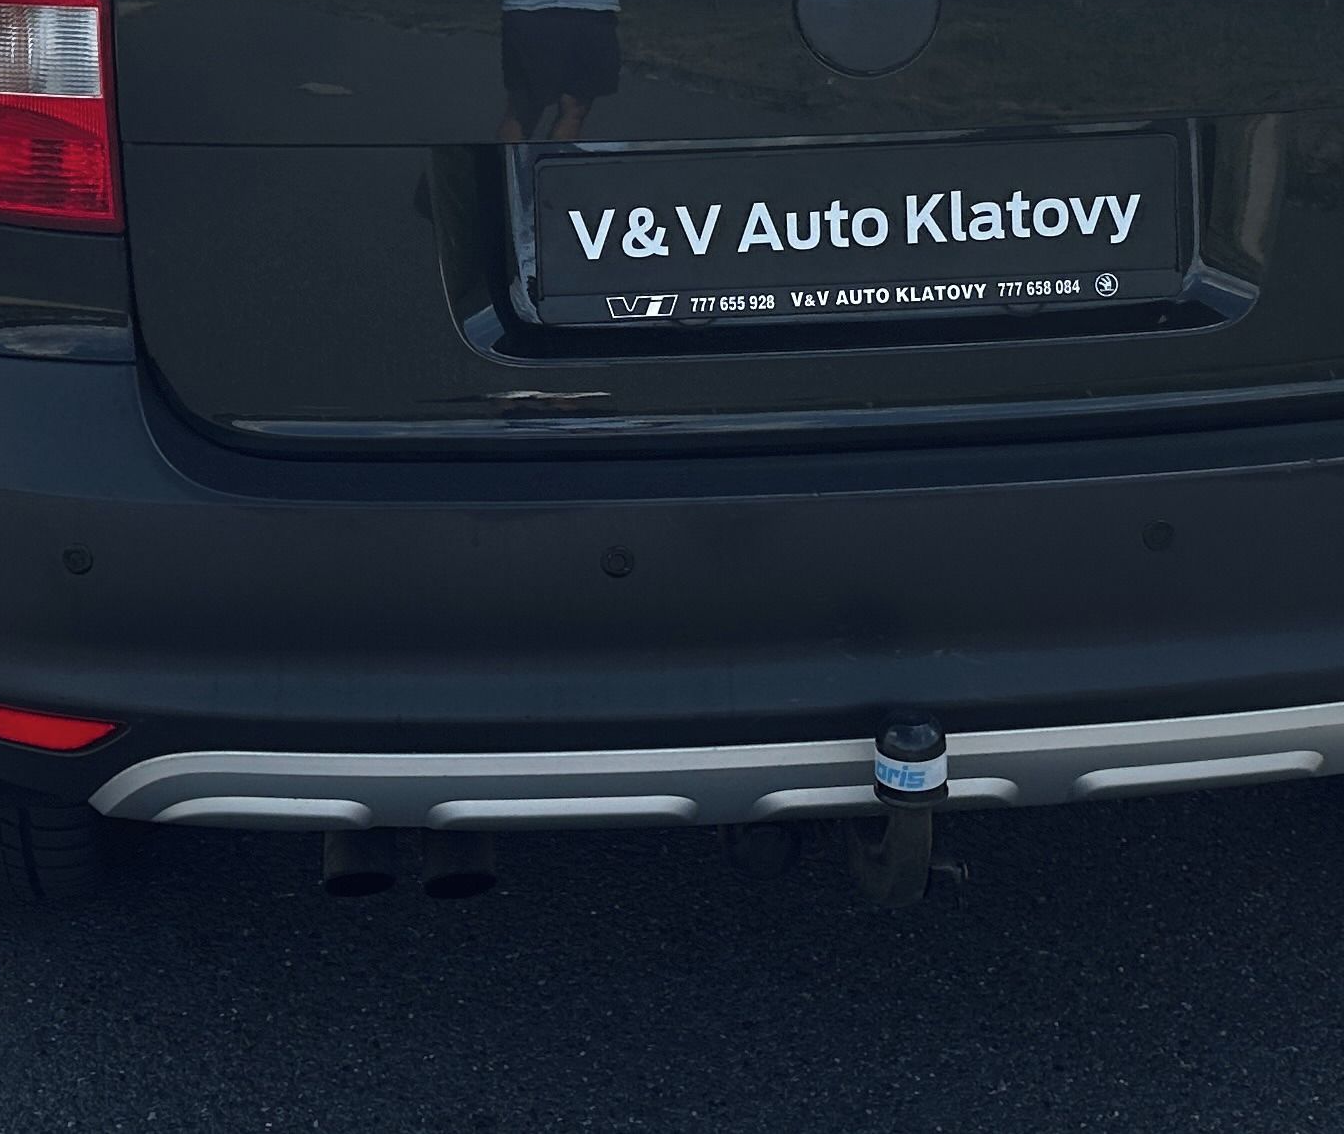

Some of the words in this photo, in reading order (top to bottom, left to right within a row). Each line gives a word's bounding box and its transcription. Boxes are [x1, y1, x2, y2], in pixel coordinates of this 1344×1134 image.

[737, 200, 889, 253] Auto
[906, 190, 1141, 245] Klatovy
[691, 297, 716, 312] 777
[720, 296, 746, 311] 655
[749, 294, 775, 309] 928
[791, 290, 830, 307] V&V
[836, 288, 890, 306] AUTO
[896, 283, 987, 303] KLATOVY
[998, 281, 1023, 297] 777
[1026, 280, 1052, 296] 658
[1056, 279, 1081, 294] 084
